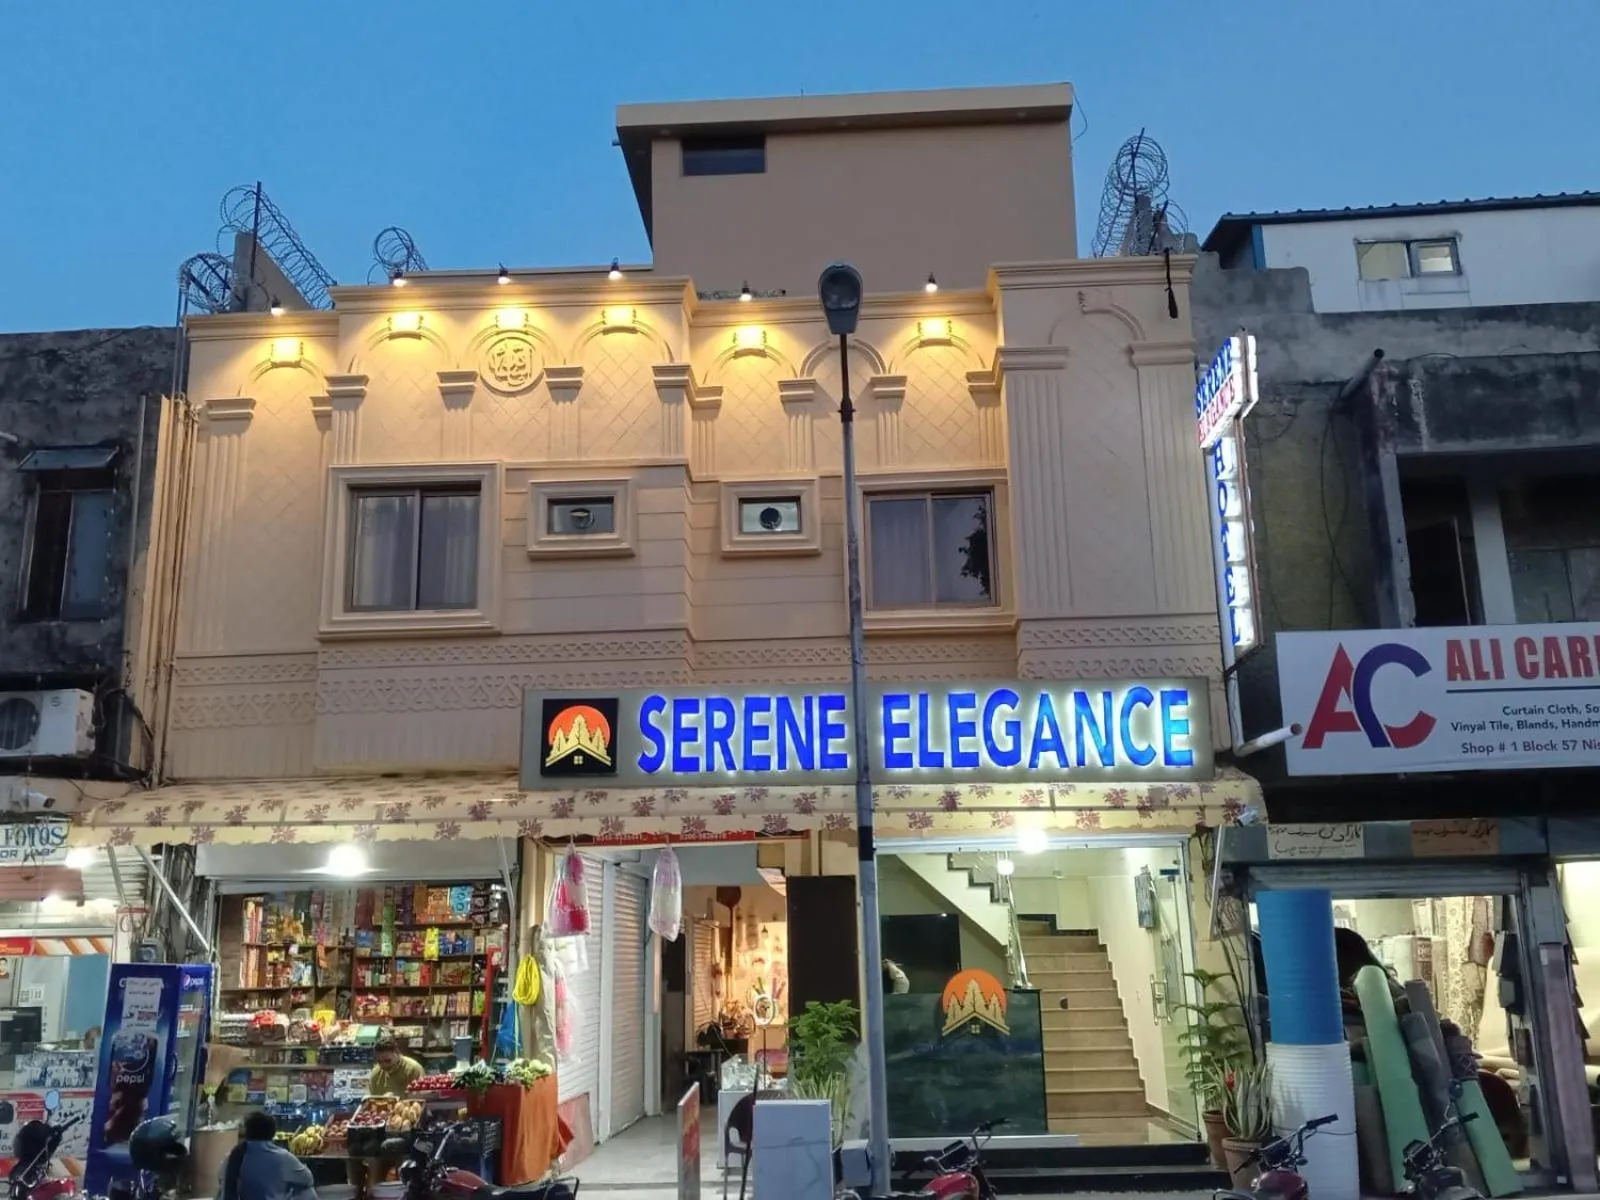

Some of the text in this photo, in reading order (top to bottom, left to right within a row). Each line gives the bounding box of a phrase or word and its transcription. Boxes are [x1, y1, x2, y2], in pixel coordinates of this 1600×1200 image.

[1446, 638, 1505, 681] ALI
[1302, 641, 1438, 749] AC
[1502, 705, 1544, 716] Curtain
[1547, 703, 1582, 715] Cloth,
[637, 688, 1194, 774] SERENE ELEGANCE
[1450, 720, 1486, 734] Vinyal
[1489, 720, 1513, 732] Tile,
[1517, 719, 1558, 731] Blands,
[1461, 741, 1494, 756] Shop
[1499, 742, 1506, 753] #
[1511, 741, 1518, 752] 1
[1523, 740, 1557, 752] Block
[1562, 739, 1578, 752] 57
[116, 1073, 145, 1085] pepsi
